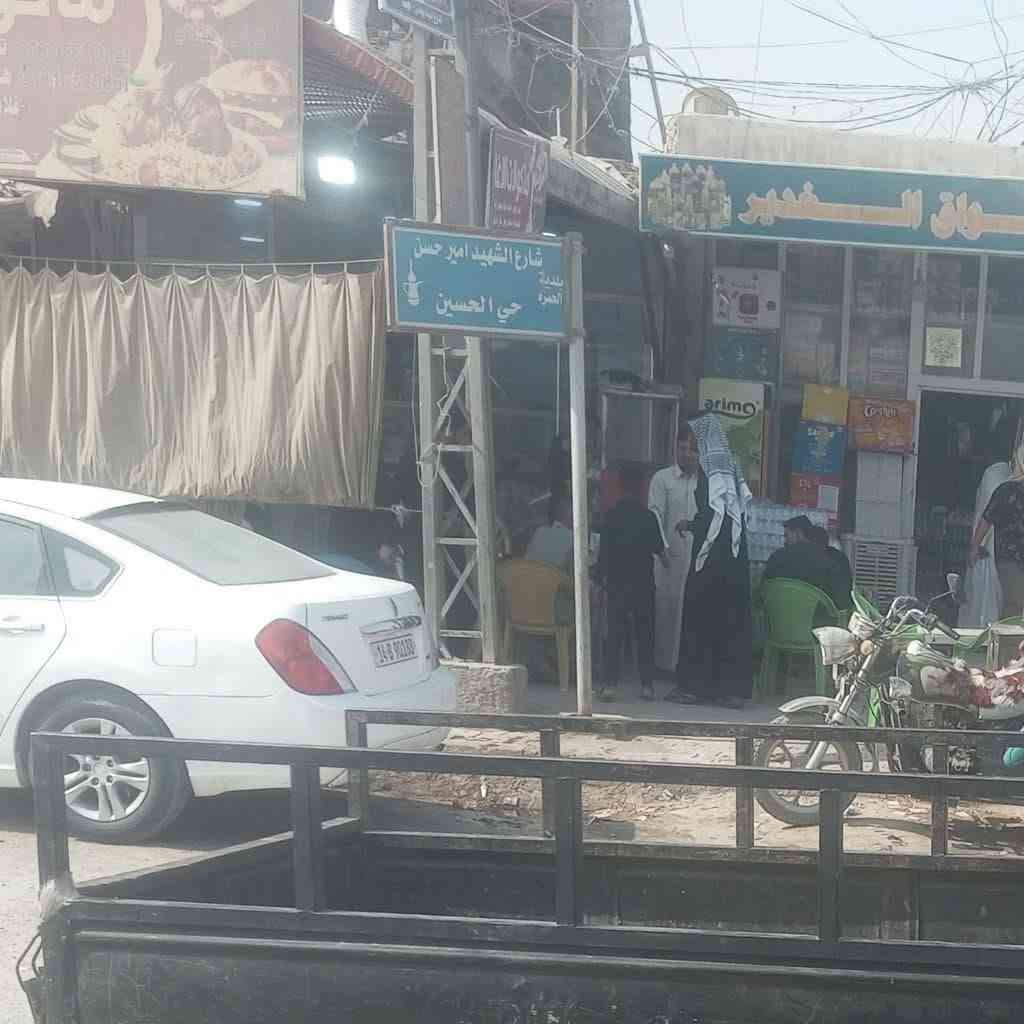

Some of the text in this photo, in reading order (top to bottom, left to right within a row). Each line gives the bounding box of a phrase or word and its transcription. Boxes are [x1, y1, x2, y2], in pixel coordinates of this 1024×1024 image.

[413, 237, 544, 271] شارع الشهيد امير حسن
[435, 292, 523, 324] حي الحسين
